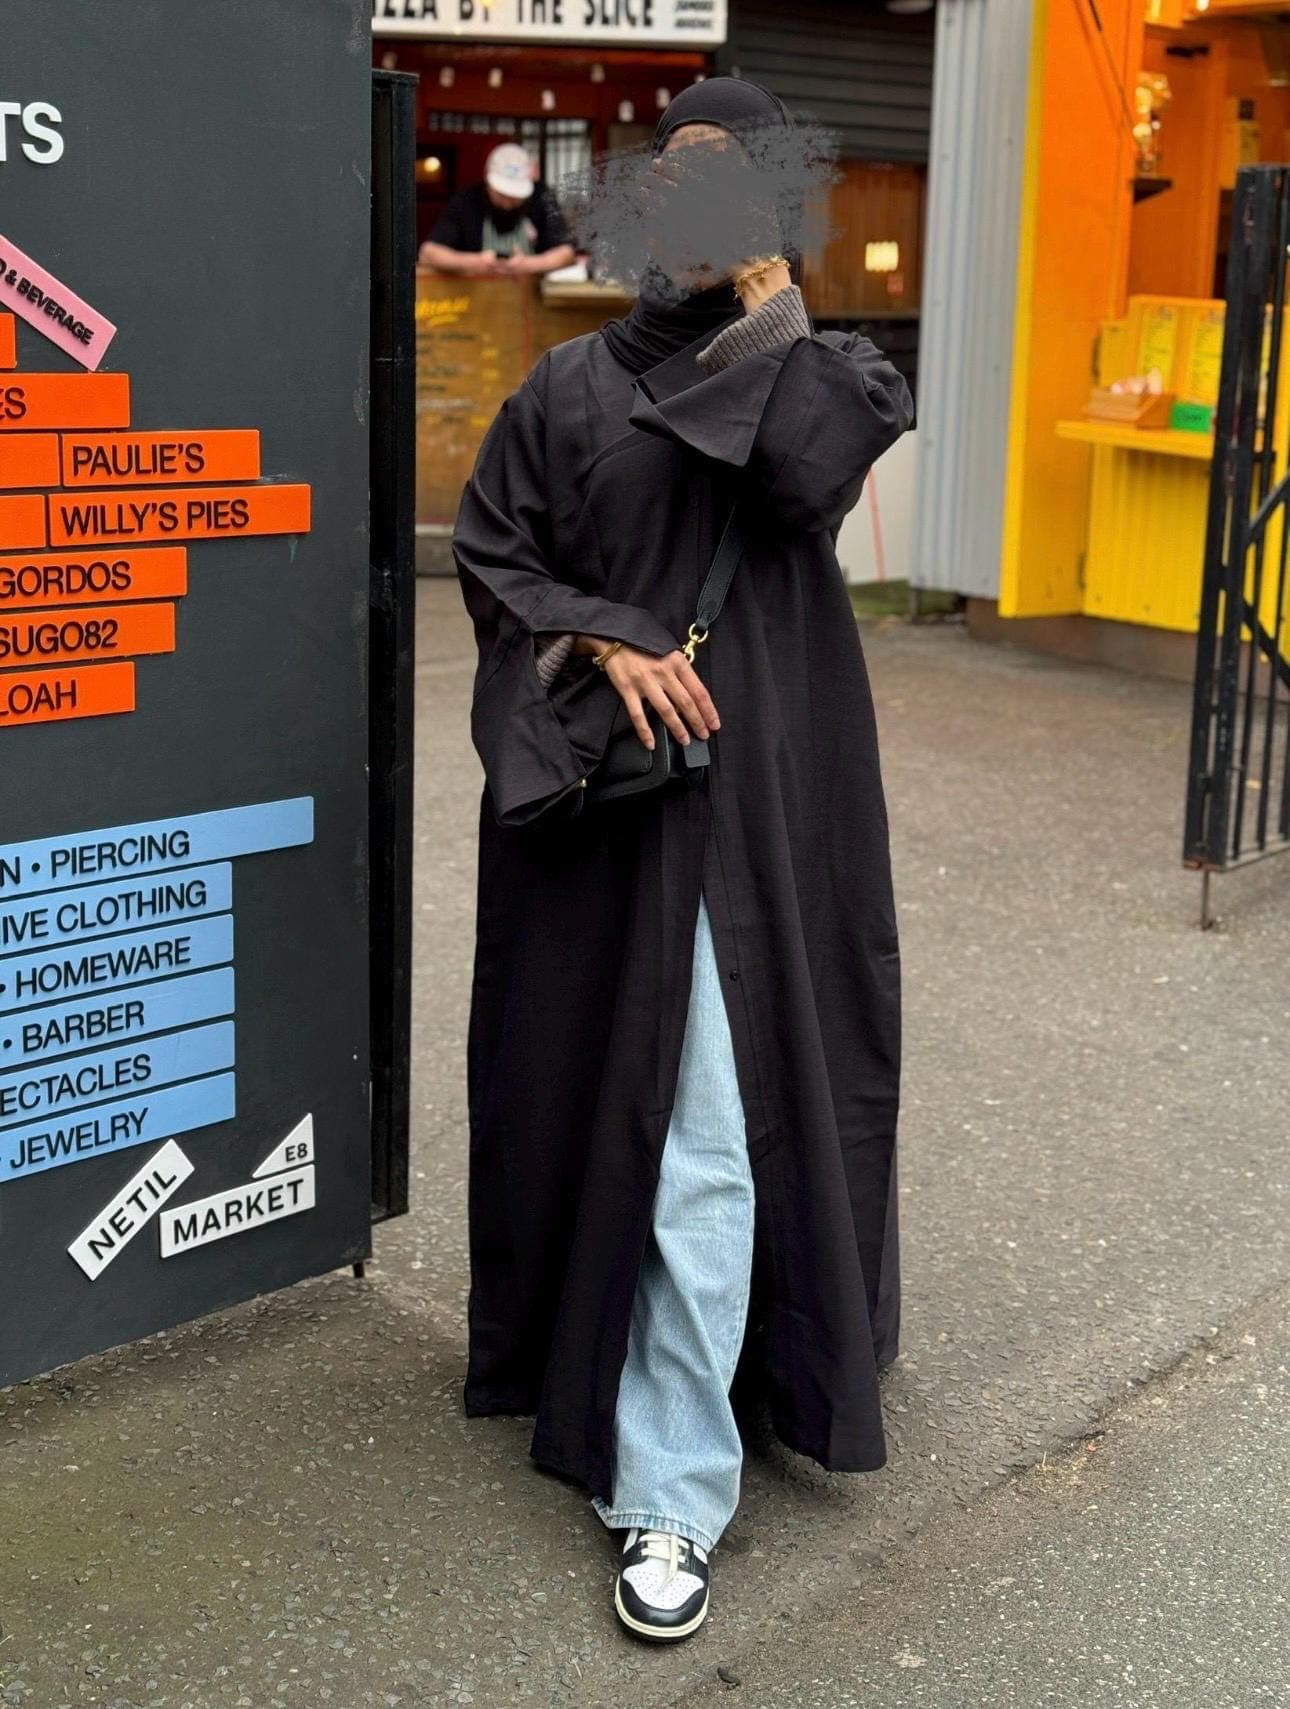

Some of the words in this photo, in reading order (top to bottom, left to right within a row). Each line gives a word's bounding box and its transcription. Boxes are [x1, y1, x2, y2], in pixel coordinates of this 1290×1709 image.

[17, 277, 95, 346] BEVERAGE
[72, 443, 205, 476] PAULIE'S
[61, 501, 179, 536] WILLY'S
[187, 499, 250, 529] PIES
[0, 561, 132, 598] GORDOS
[0, 619, 118, 657] SUGO82
[51, 830, 190, 878] PIERCING
[2, 908, 49, 945] IVE
[56, 880, 207, 933] CLOTHING
[16, 936, 191, 998] HOMEWARE
[23, 1000, 145, 1053] BARBER
[0, 1053, 151, 1116] ECTACLES
[10, 1107, 149, 1169] JEWELRY
[285, 1142, 308, 1163] E8
[87, 1170, 177, 1261] NETIL
[173, 1179, 305, 1246] MARKET
